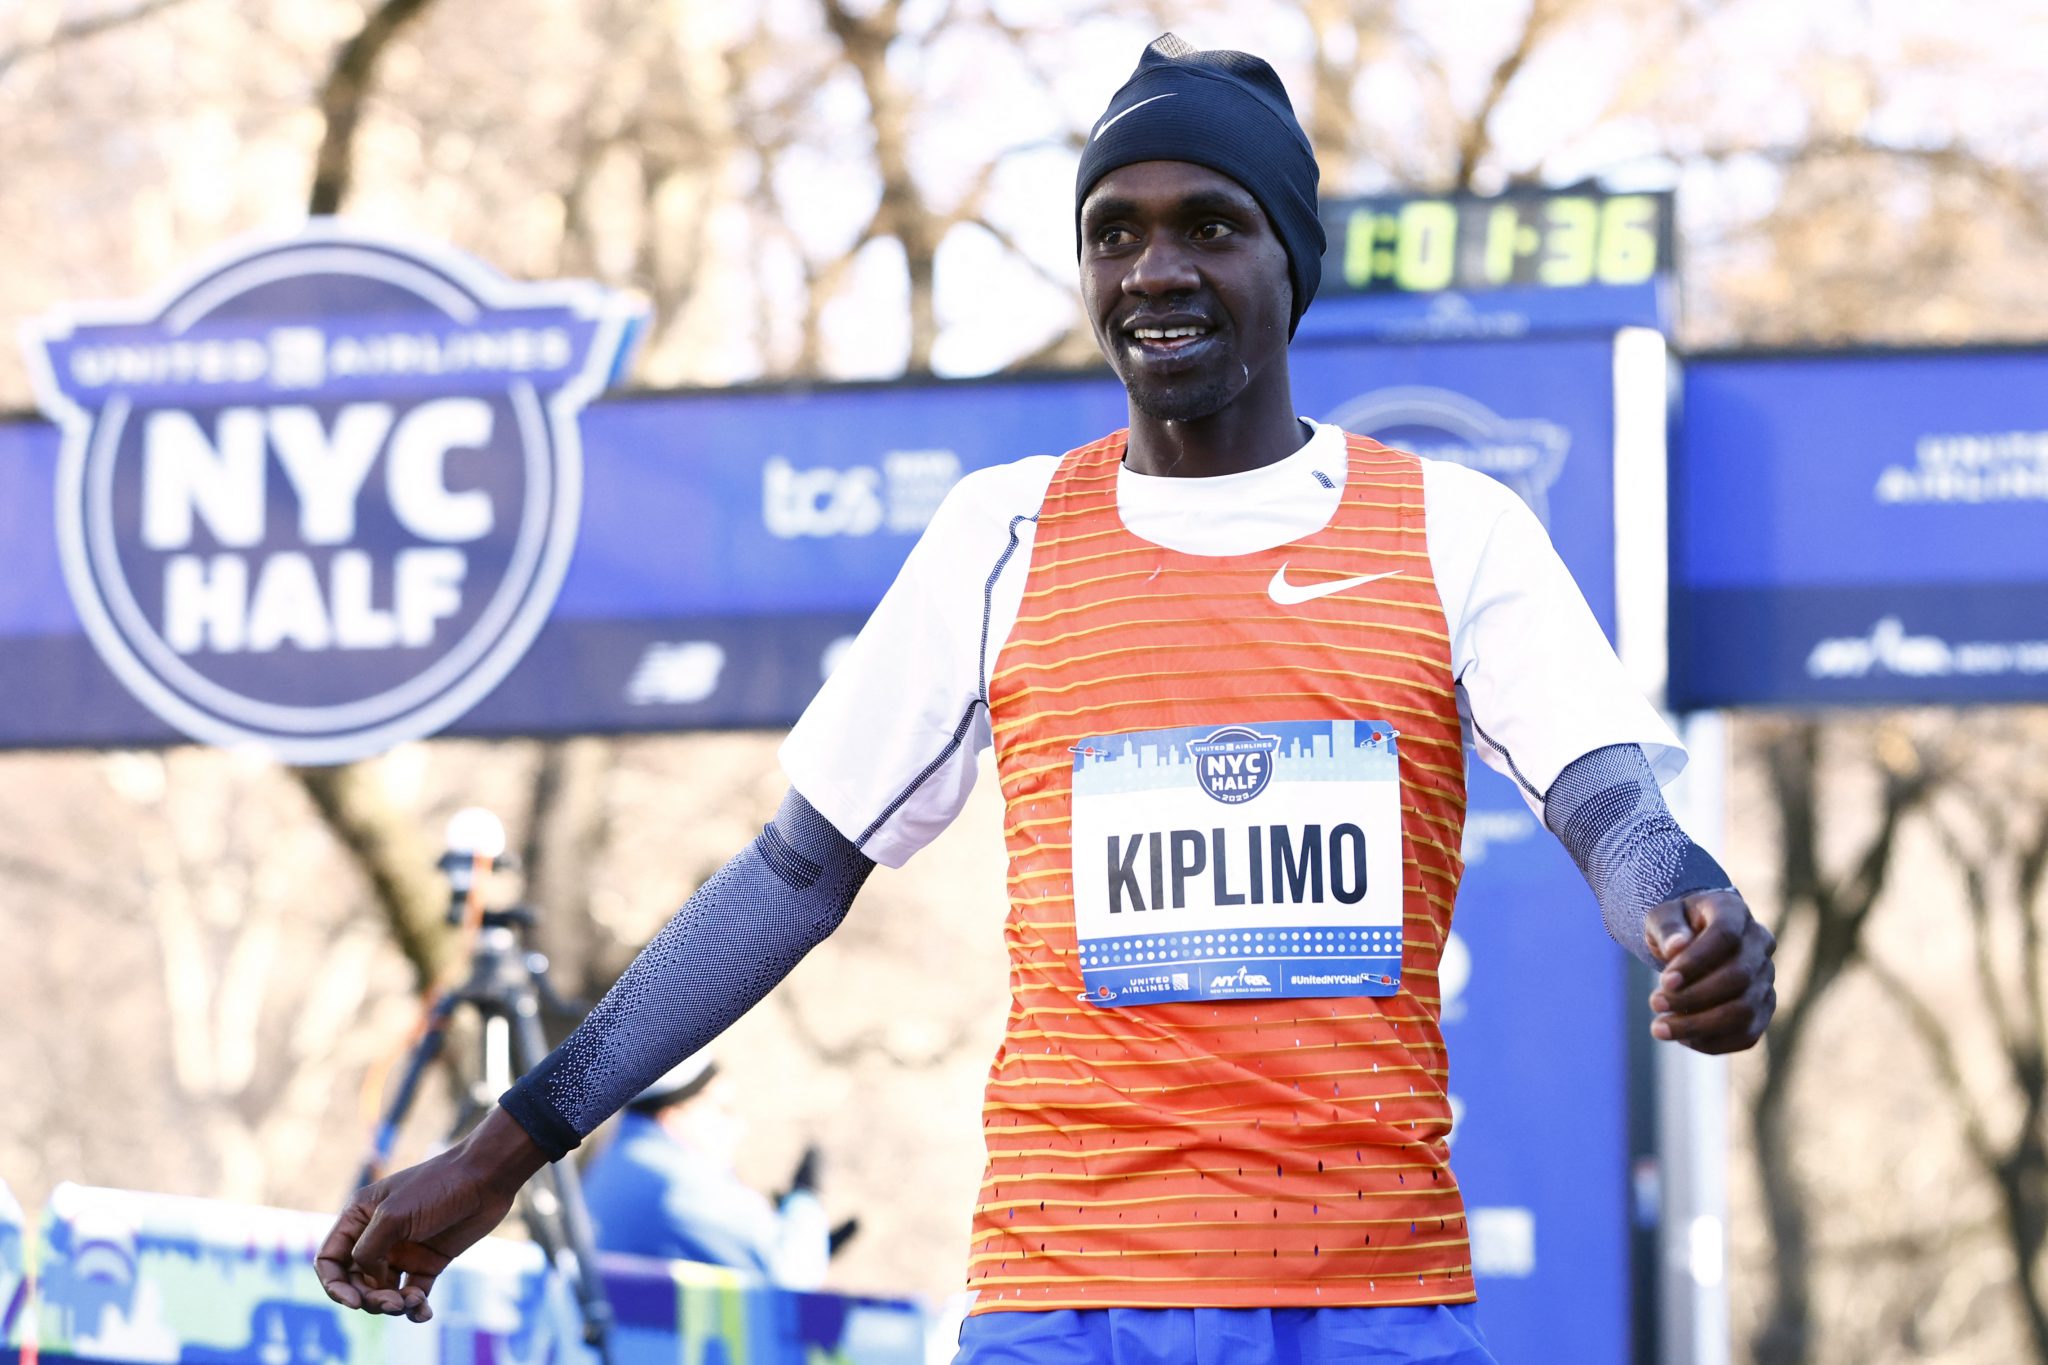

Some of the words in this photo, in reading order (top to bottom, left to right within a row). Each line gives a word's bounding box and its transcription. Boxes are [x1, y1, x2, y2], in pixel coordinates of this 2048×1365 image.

[142, 398, 495, 550] NYC
[163, 549, 468, 653] HALF
[1235, 742, 1272, 750] AIRLINES
[1207, 753, 1261, 776] NYC
[1212, 775, 1257, 791] HALF
[1222, 792, 1250, 802] 2023
[1107, 823, 1368, 914] KIPLIMO
[1122, 983, 1171, 994] AIRLINES
[1130, 976, 1170, 986] UNITED
